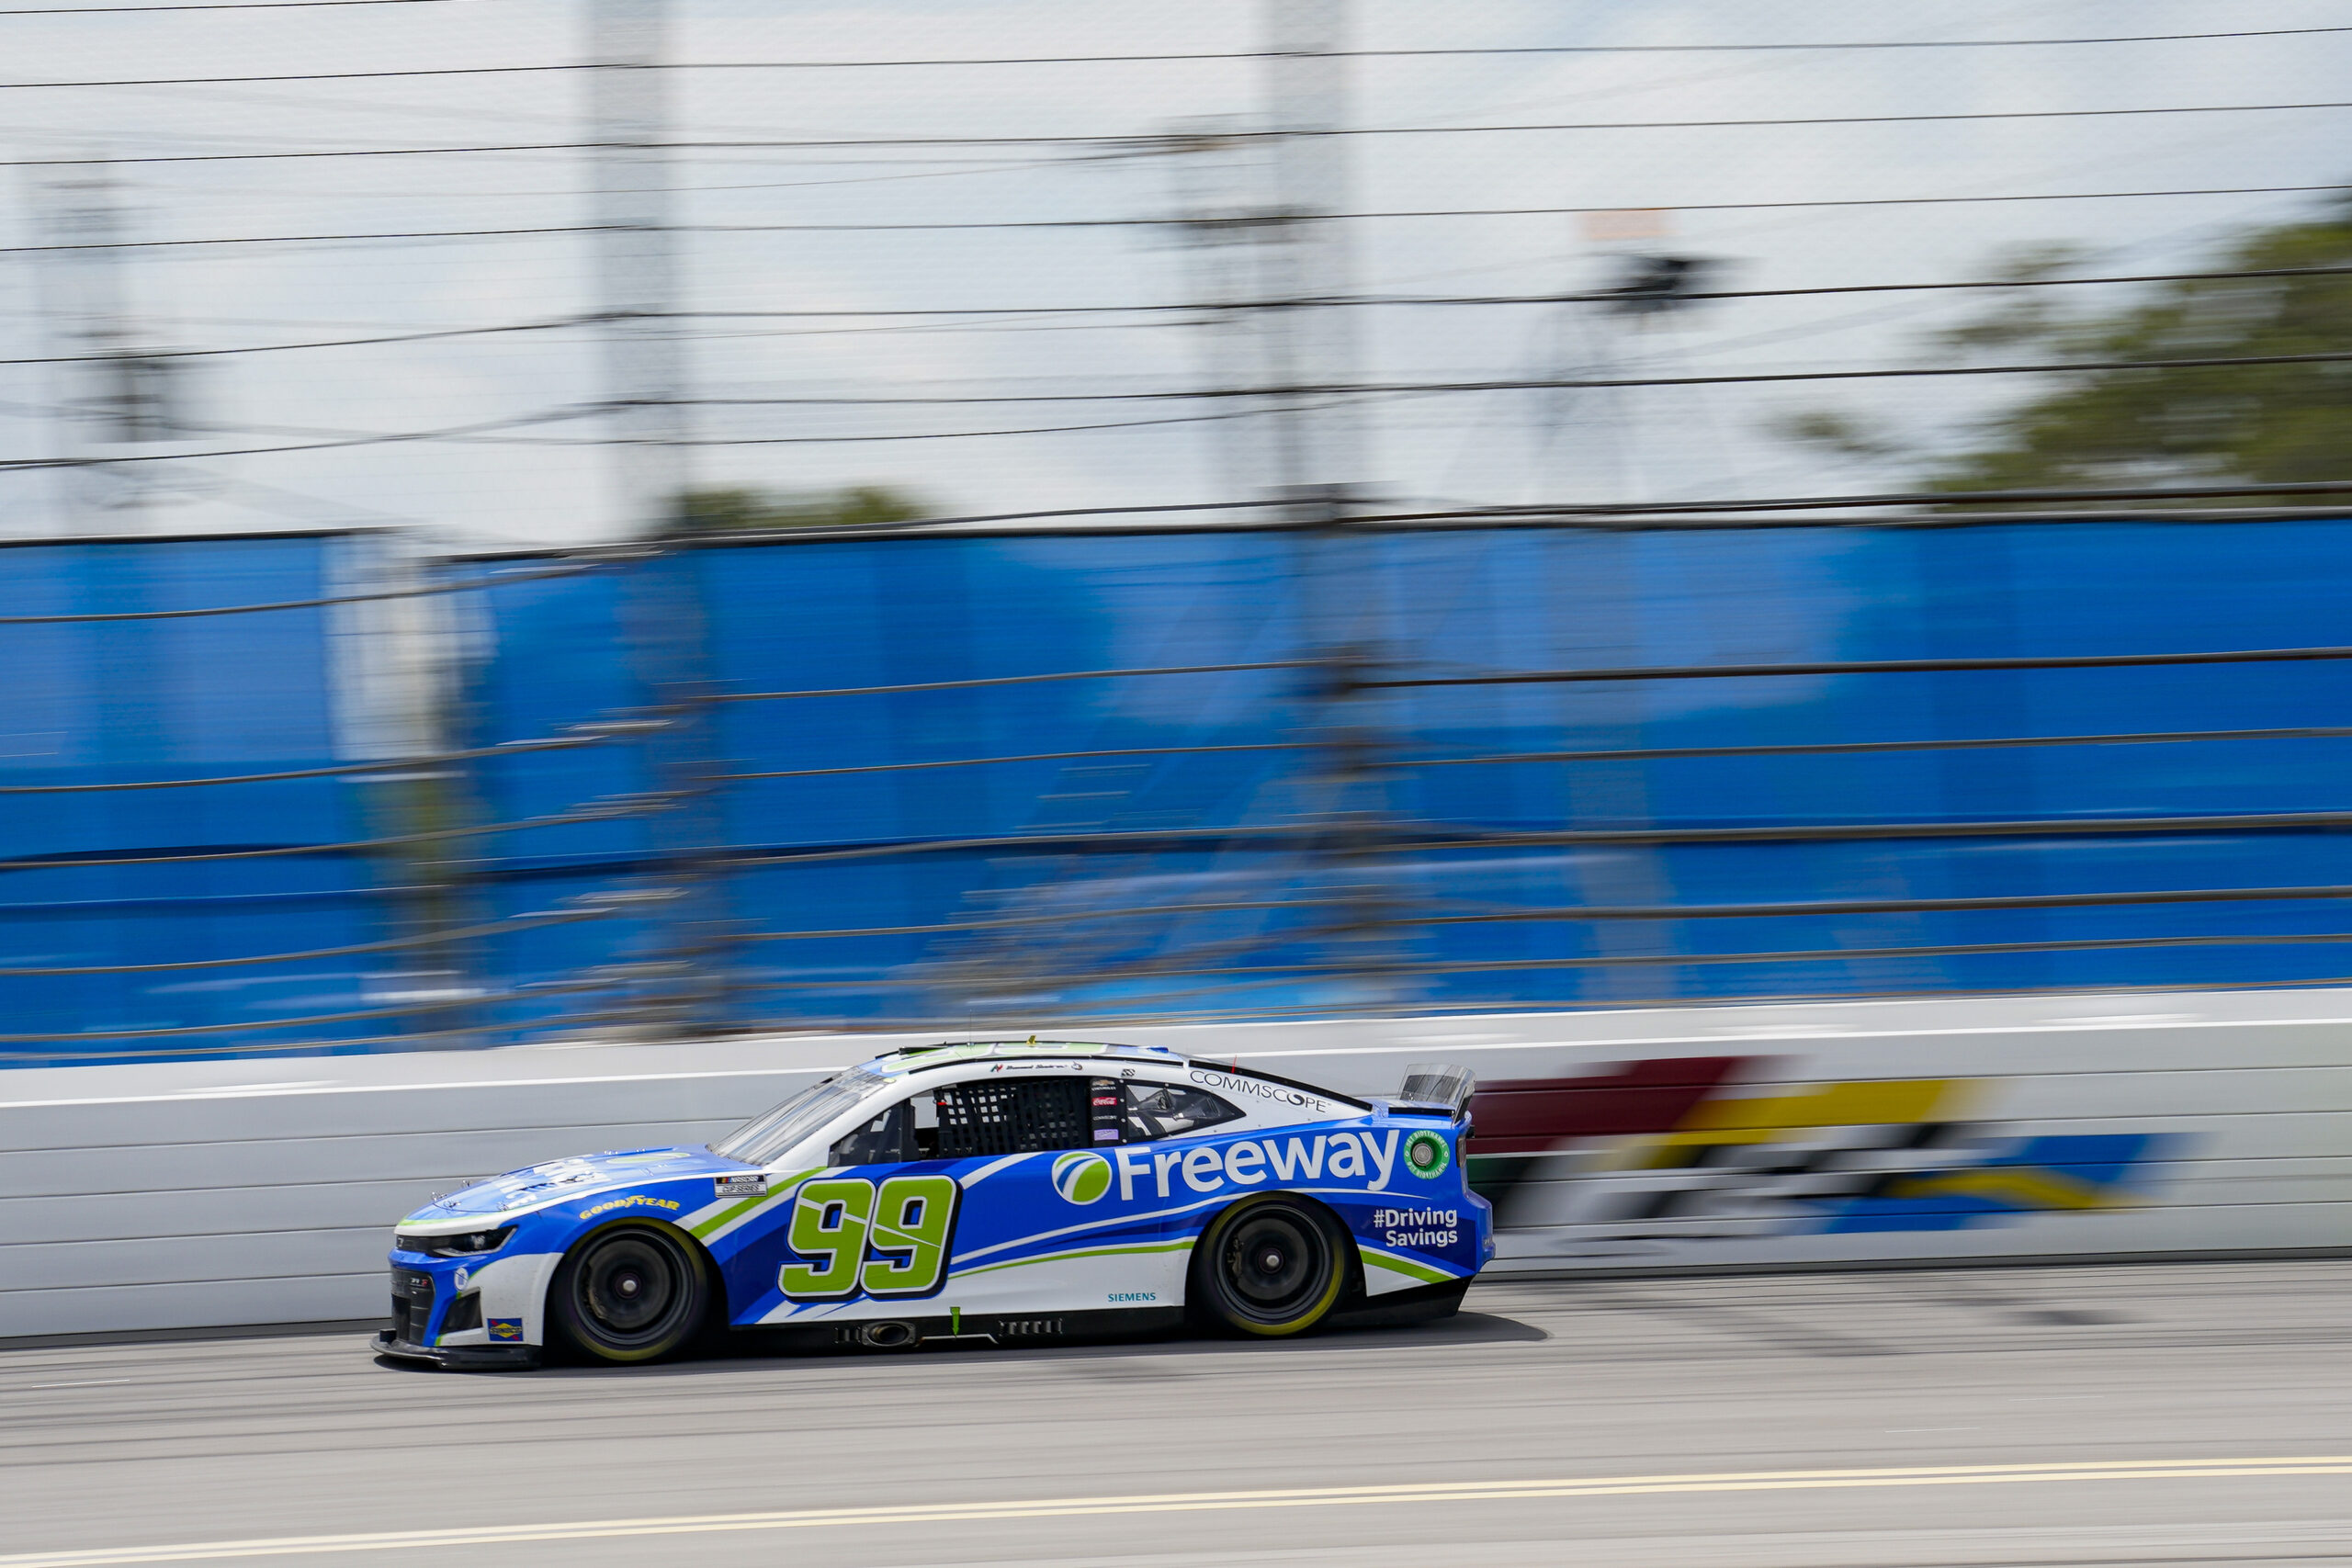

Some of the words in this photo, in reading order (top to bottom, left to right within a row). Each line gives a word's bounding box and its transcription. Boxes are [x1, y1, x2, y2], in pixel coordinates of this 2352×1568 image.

[1190, 1070, 1327, 1113] COMMSCOPE
[1114, 1129, 1400, 1201] Freeway
[580, 1194, 681, 1220] GOODYEAR
[1374, 1207, 1457, 1228] #Driving
[777, 1174, 961, 1299] 99
[1385, 1227, 1458, 1247] Savings
[1107, 1292, 1157, 1303] SIEMENS
